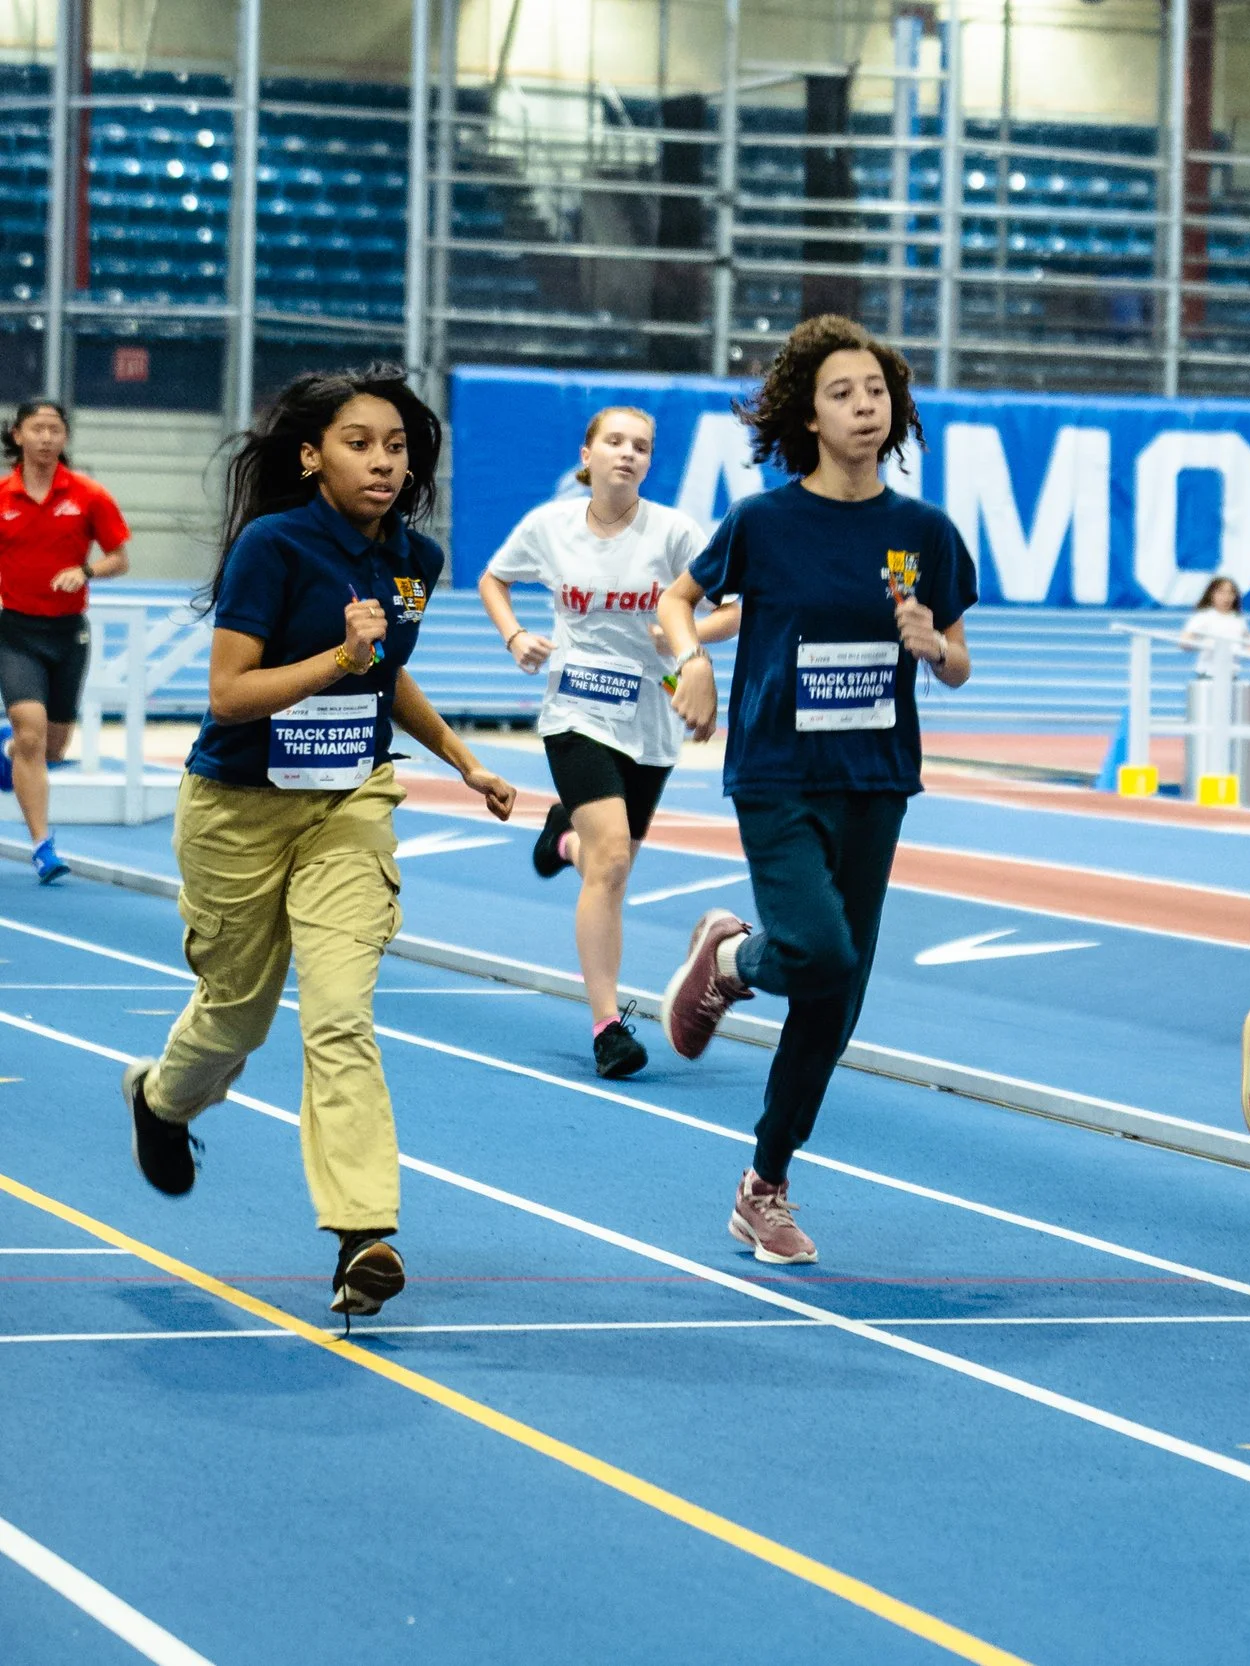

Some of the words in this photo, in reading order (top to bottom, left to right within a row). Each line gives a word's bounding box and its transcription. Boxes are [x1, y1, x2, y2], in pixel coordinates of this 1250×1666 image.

[566, 668, 599, 683] TRACK
[600, 674, 627, 688] STAR
[627, 680, 639, 690] IN
[801, 672, 846, 687] TRACK
[847, 671, 878, 686] STAR
[880, 670, 893, 684] IN
[570, 678, 588, 691] THE
[589, 681, 631, 698] MAKING
[809, 685, 833, 700] THE
[835, 684, 884, 700] MAKING
[275, 727, 326, 741] TRACK
[327, 726, 361, 741] STAR
[362, 725, 374, 739] IN
[283, 741, 312, 755] THE
[313, 741, 367, 755] MAKING
